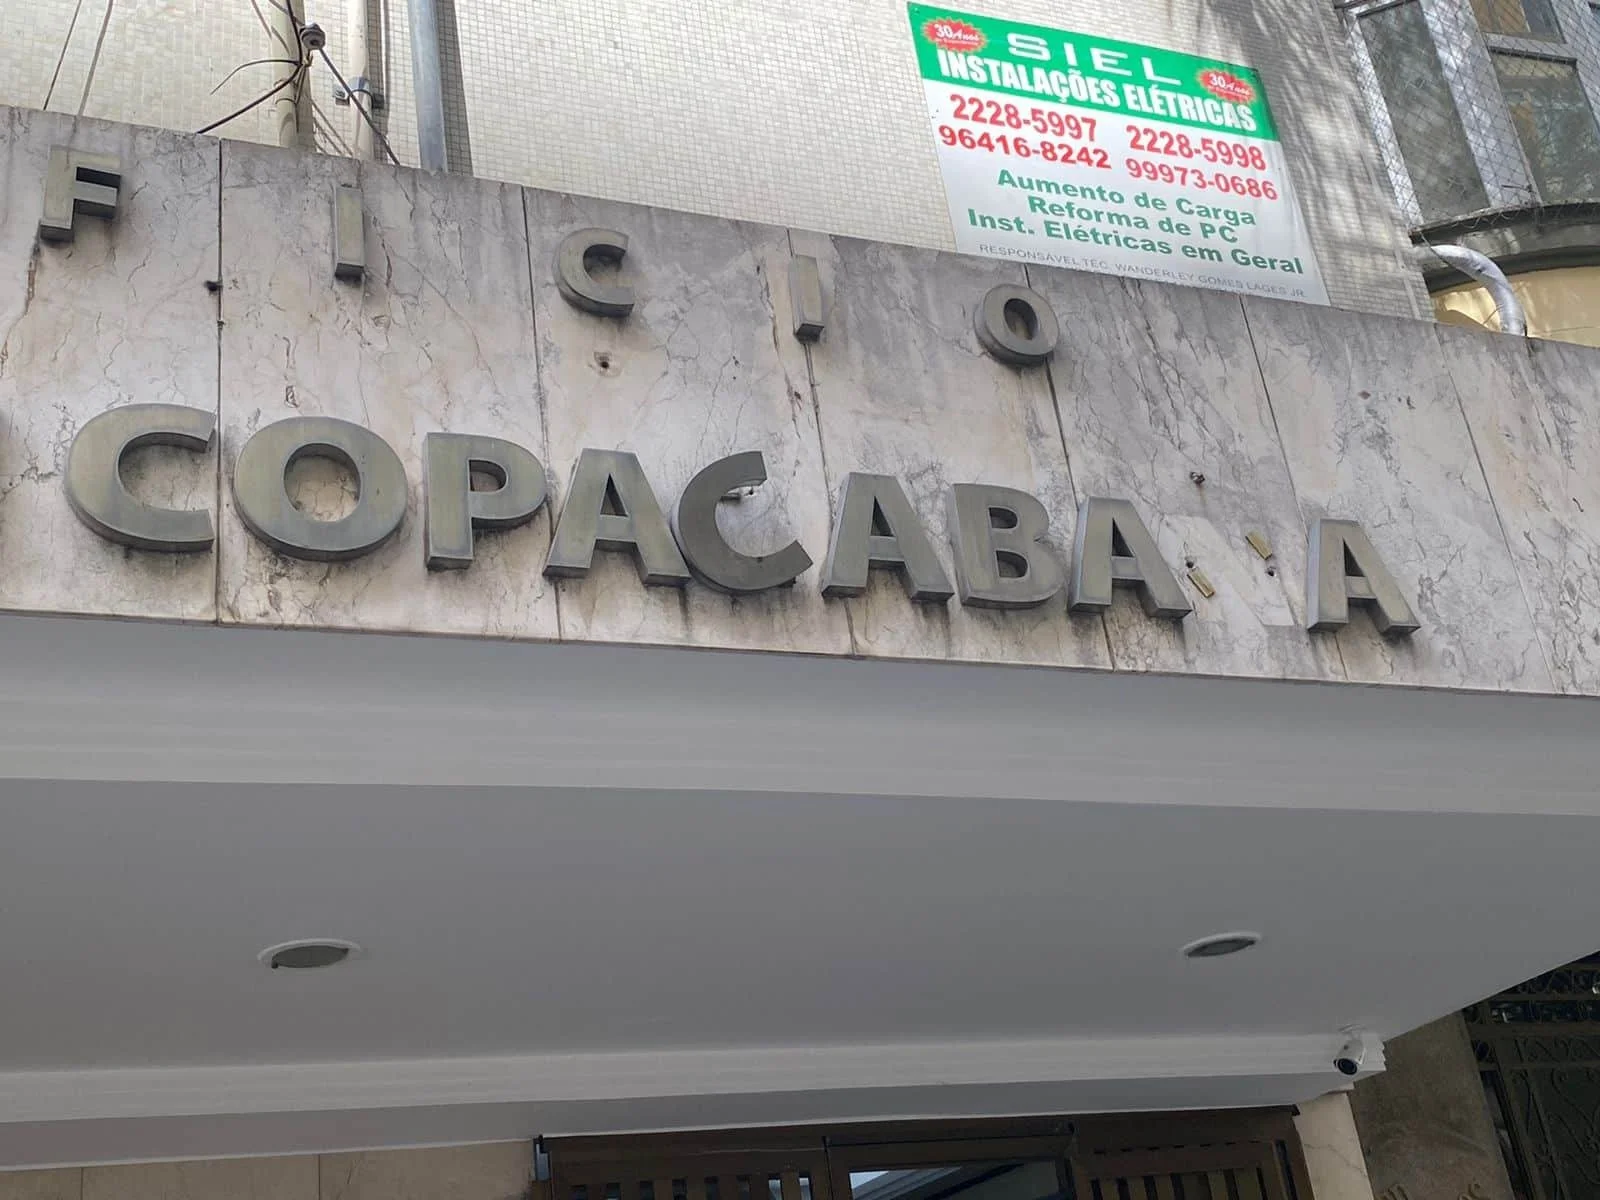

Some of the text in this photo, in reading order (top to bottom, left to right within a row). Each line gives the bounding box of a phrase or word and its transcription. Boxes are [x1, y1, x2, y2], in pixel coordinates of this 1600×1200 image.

[933, 22, 953, 40] 30
[1007, 32, 1181, 86] SIEL
[1208, 72, 1226, 89] 30
[936, 48, 1257, 132] INSTALAÇÕES ELÉTRICAS
[950, 94, 1097, 142] 2228-5997
[938, 125, 1112, 169] 96416-8242
[1126, 125, 1266, 171] 2228-5998
[997, 168, 1256, 228] Aumento de Carga
[1125, 158, 1278, 201] 99973-0686
[967, 208, 1304, 275] Inst. Elétricas em Geral
[1027, 195, 1239, 244] Reforma de PC
[1115, 263, 1194, 282] WANDERLEY
[1198, 275, 1243, 288] GOMES
[1245, 282, 1288, 295] LAGES
[64, 403, 1421, 632] COPACABAA
